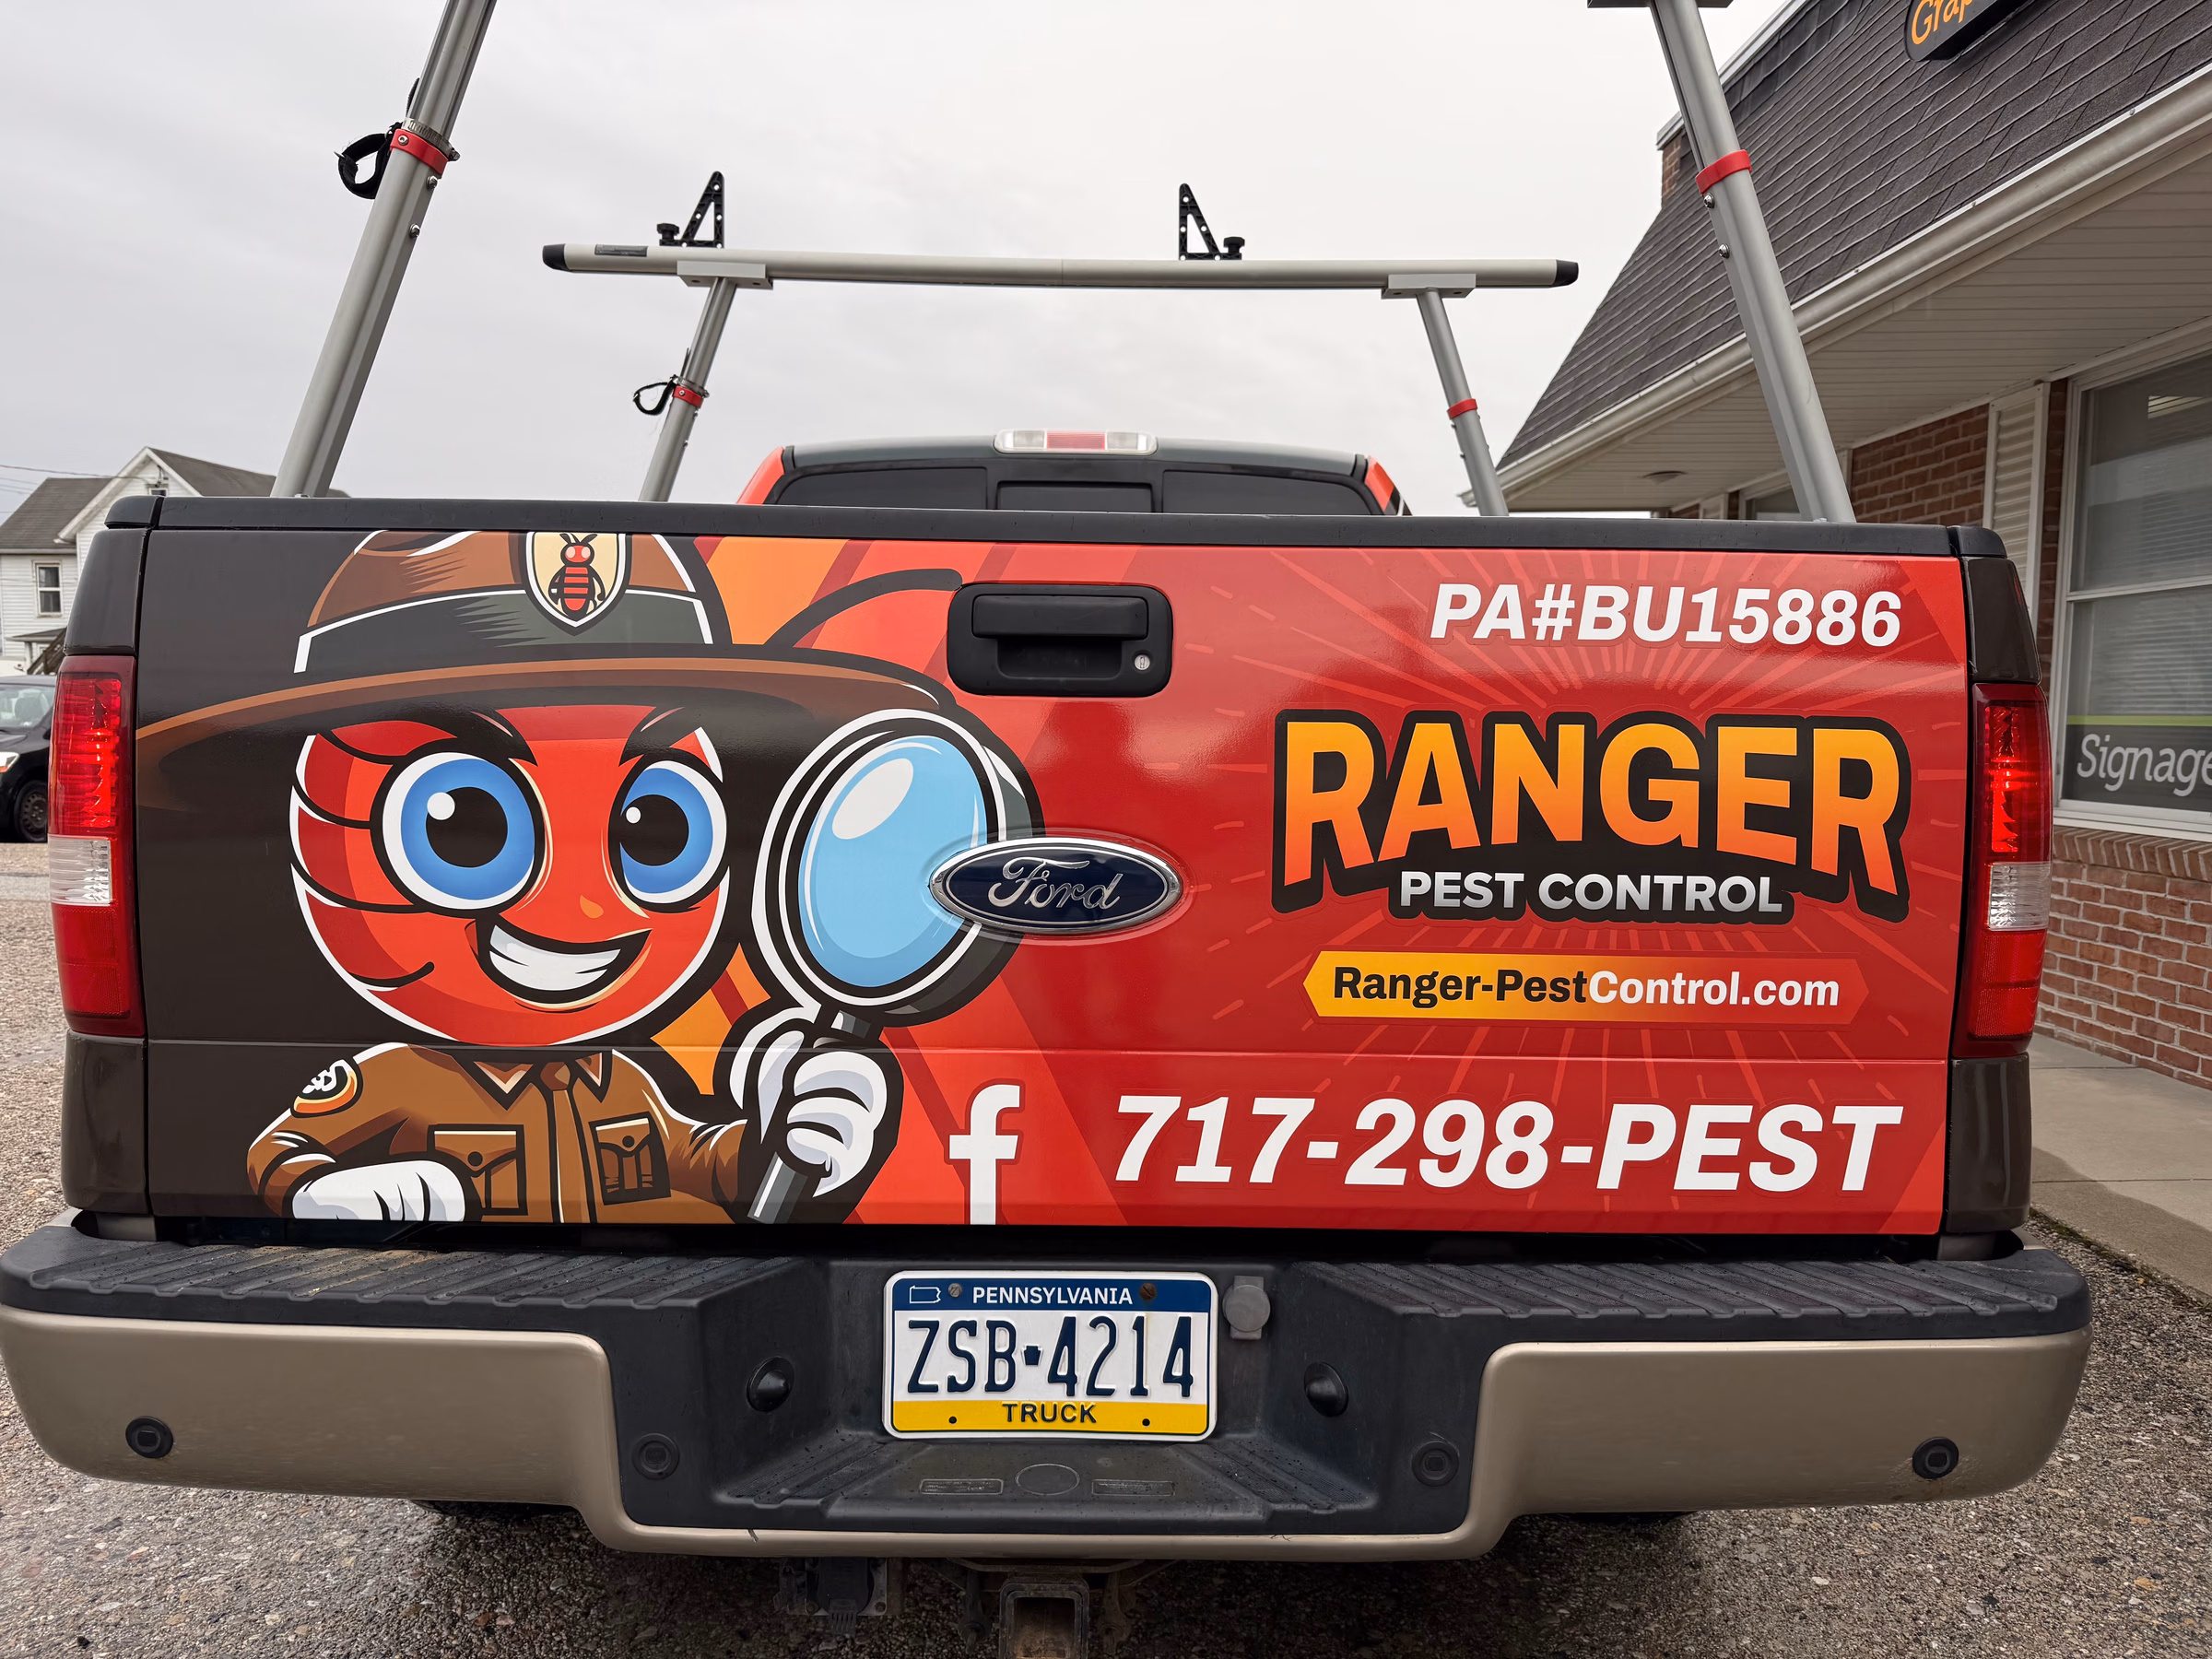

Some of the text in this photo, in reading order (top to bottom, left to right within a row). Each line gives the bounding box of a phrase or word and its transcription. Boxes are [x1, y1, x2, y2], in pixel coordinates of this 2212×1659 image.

[1430, 583, 1901, 646] PA#BU15886
[1284, 721, 1900, 897] RANGER
[988, 856, 1124, 910] Ford
[1400, 871, 1783, 912] PEST CONTROL
[1333, 966, 1840, 1008] Ranger-PestControl.com
[1114, 1094, 1903, 1192] 717-298-PEST
[972, 1287, 1133, 1305] PENNSYLVANIA
[1002, 1403, 1097, 1423] TRUCK
